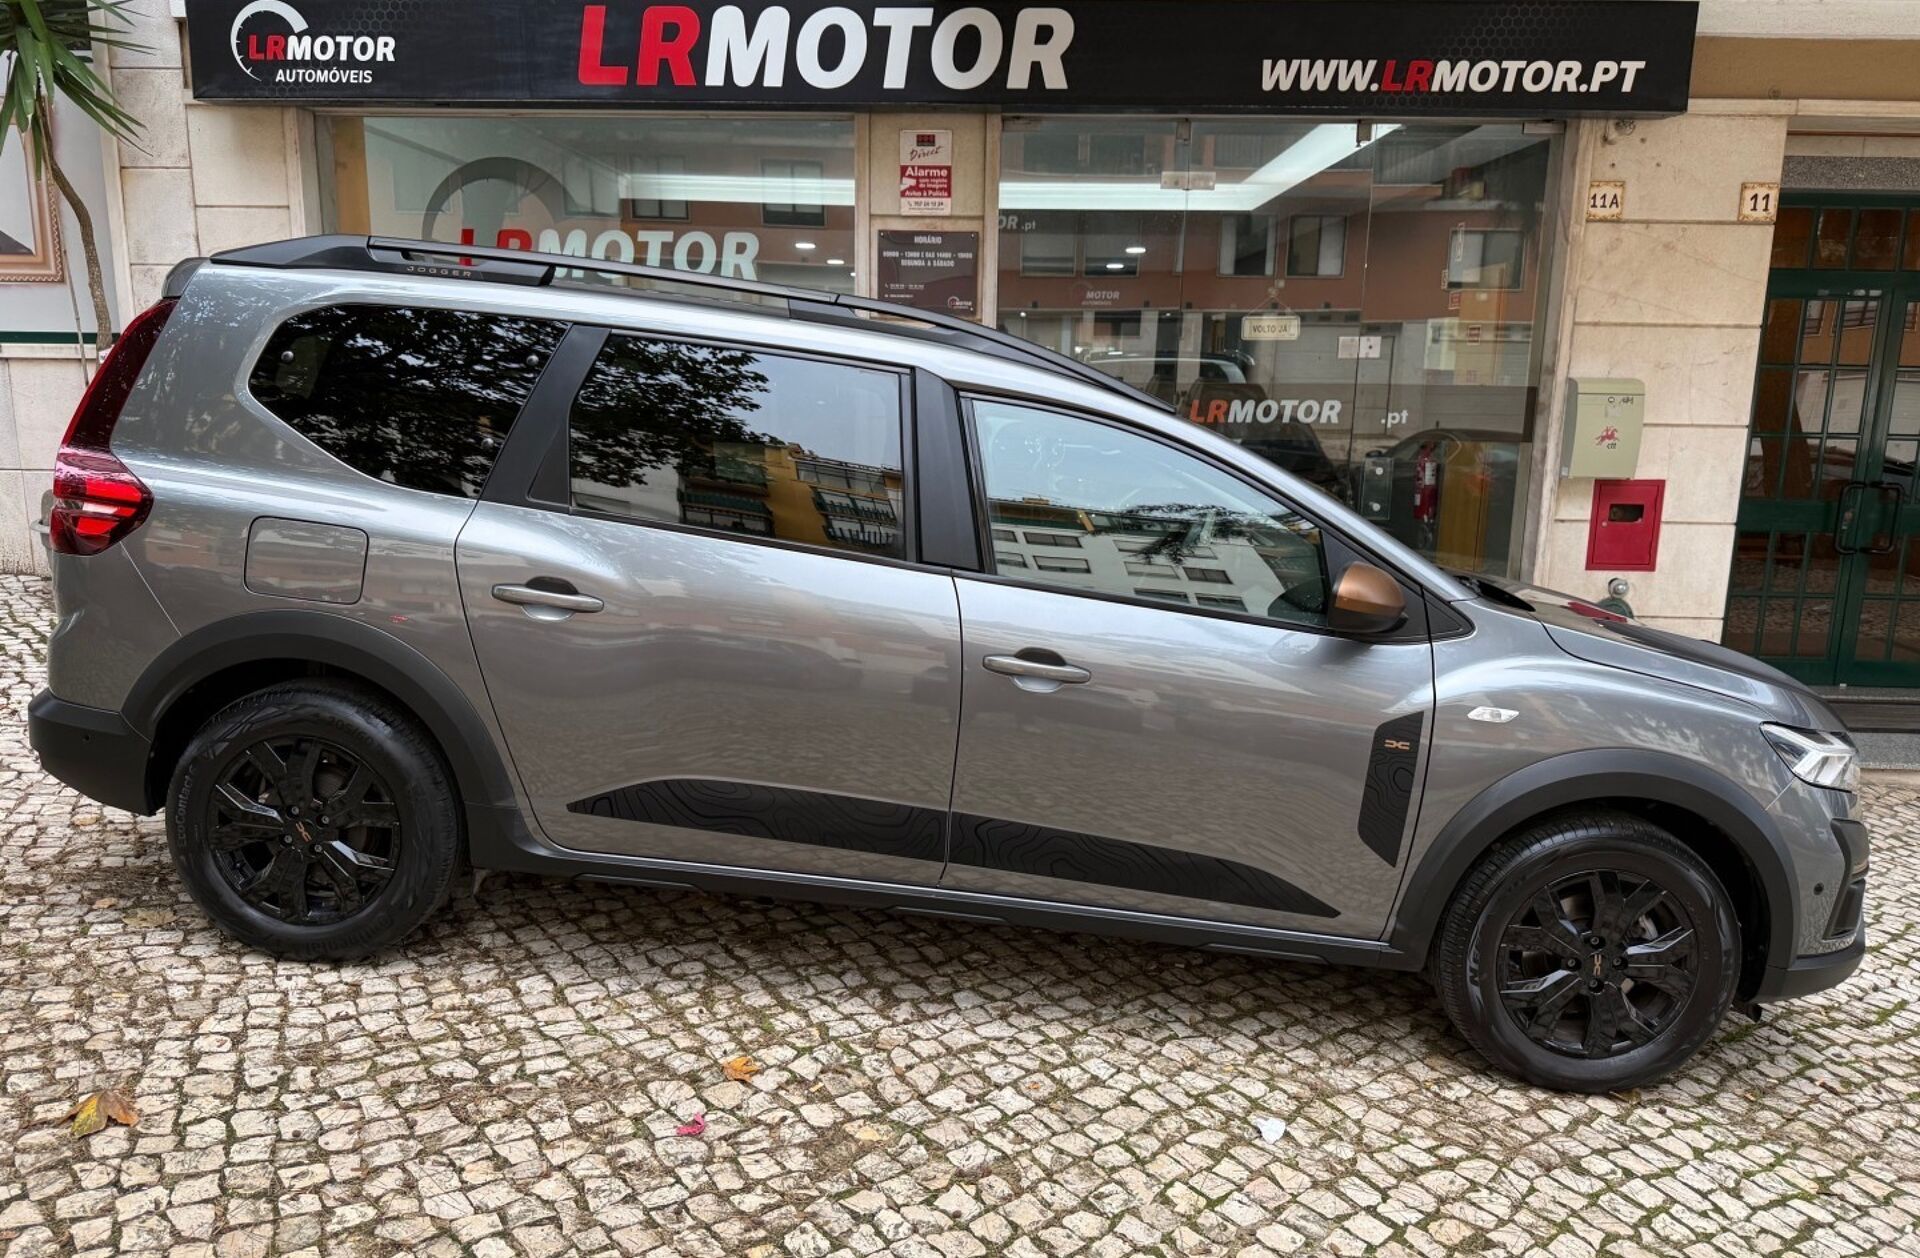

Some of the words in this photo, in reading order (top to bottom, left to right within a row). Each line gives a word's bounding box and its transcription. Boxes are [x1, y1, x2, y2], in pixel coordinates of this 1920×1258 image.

[248, 34, 396, 62] LRMOTOR
[578, 5, 1075, 90] LRMOTOR
[275, 67, 373, 84] AUTOMÓVEIS
[1261, 59, 1647, 93] WWW.LRMOTOR.PT
[905, 166, 948, 177] Alarme
[1590, 193, 1619, 208] 11A
[1750, 193, 1770, 212] 11
[407, 266, 471, 277] JOGGER
[1252, 324, 1277, 333] VOLTO
[1189, 399, 1342, 425] LRMOTOR
[1381, 409, 1409, 428] .pt
